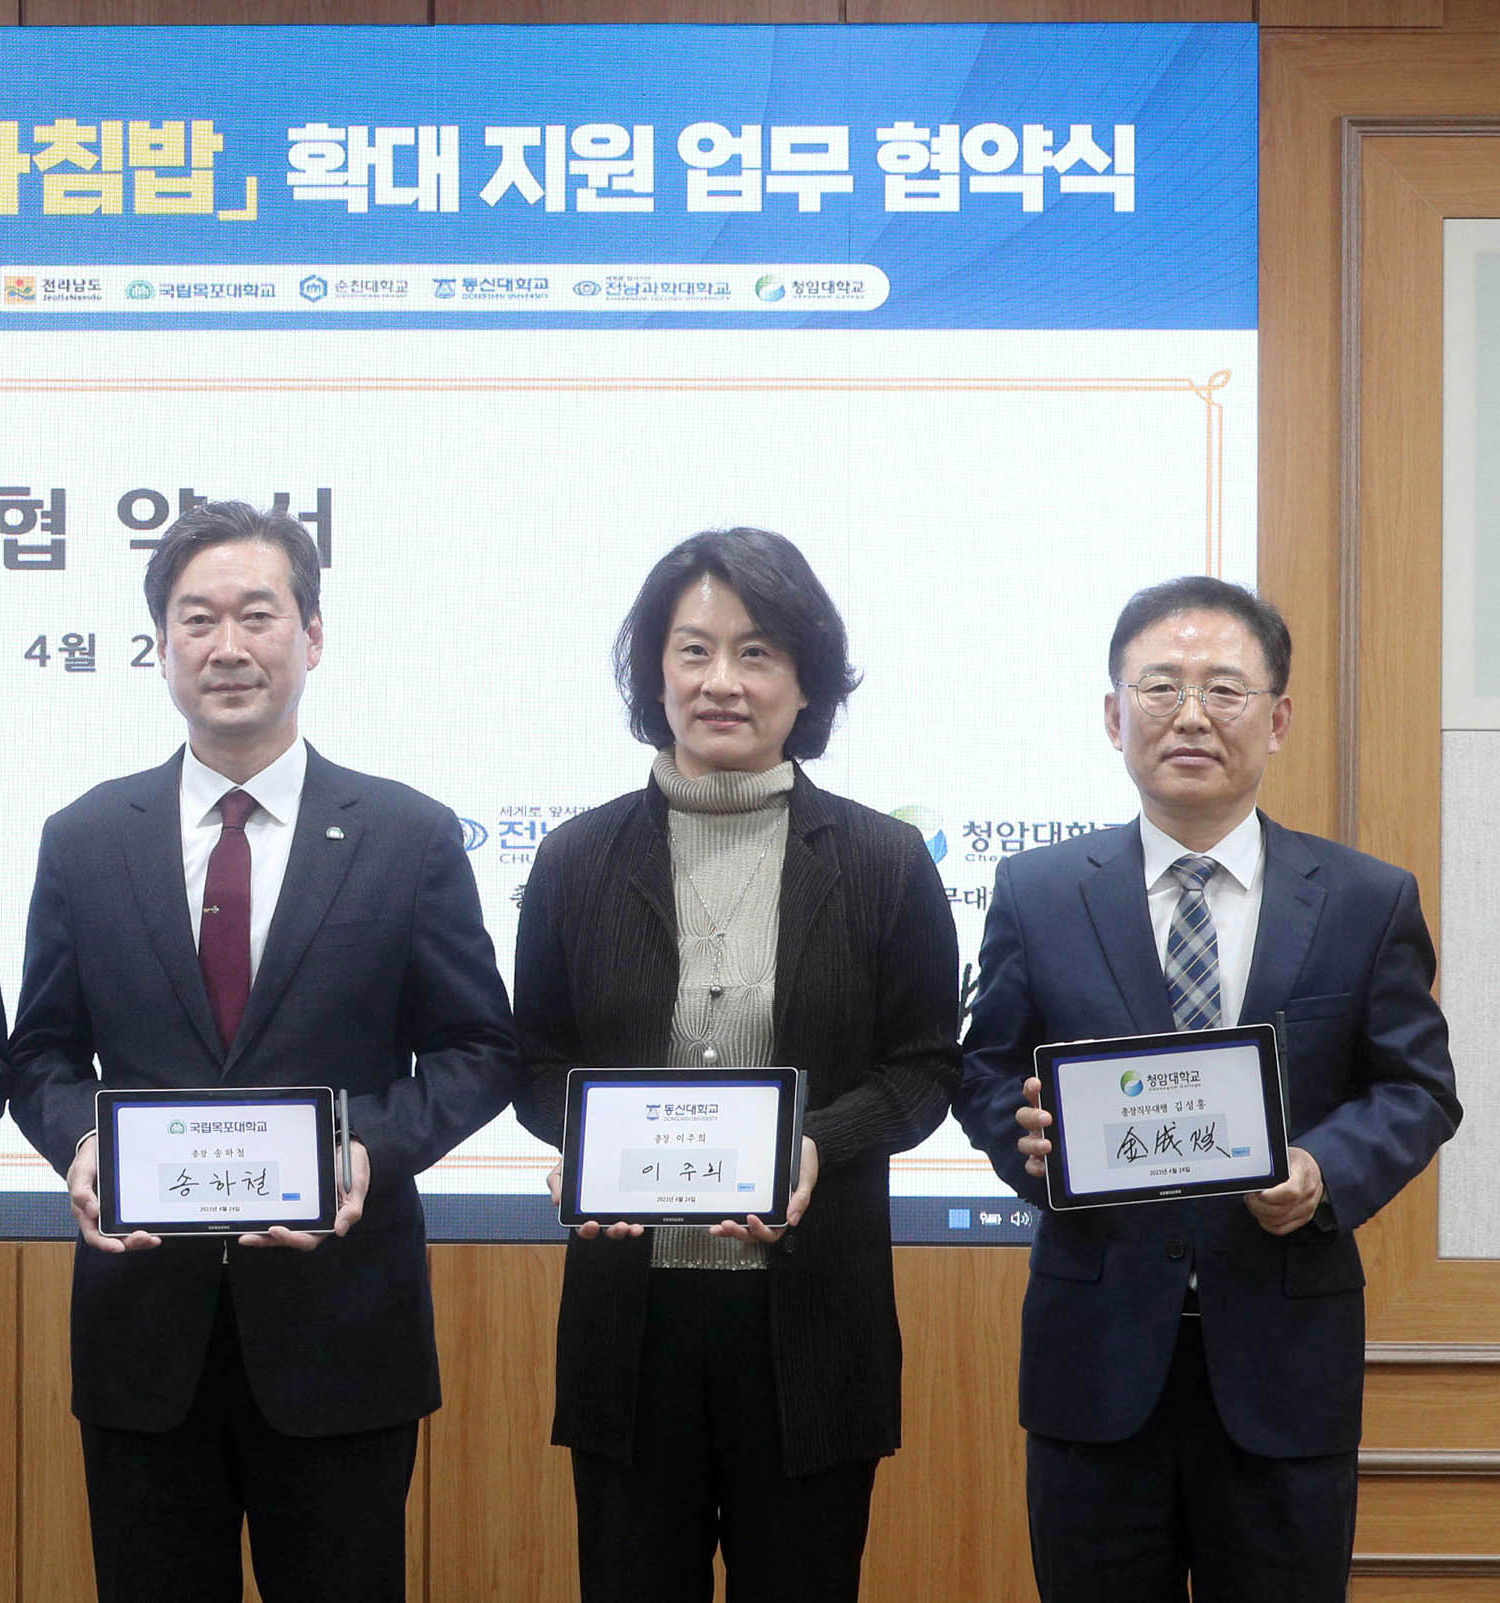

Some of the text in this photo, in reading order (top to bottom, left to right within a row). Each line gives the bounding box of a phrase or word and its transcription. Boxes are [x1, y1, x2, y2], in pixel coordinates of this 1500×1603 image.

[286, 121, 460, 214] 확대
[478, 122, 656, 214] 지원
[676, 121, 854, 214] 업무
[875, 120, 1137, 214] 협약식
[41, 278, 103, 293] 전라남도
[158, 282, 277, 299] 국립목포대학교
[335, 279, 409, 294] 순천대학교
[461, 277, 549, 292] 동신대학교
[604, 279, 732, 297] 전남과학대학교
[791, 280, 866, 294] 청암대학교
[24, 632, 98, 673] 4월
[499, 820, 551, 850] 전
[1146, 1070, 1201, 1088] 청암대학교
[664, 1103, 719, 1116] 동신대학교
[189, 1121, 268, 1134] 국립목포대학교
